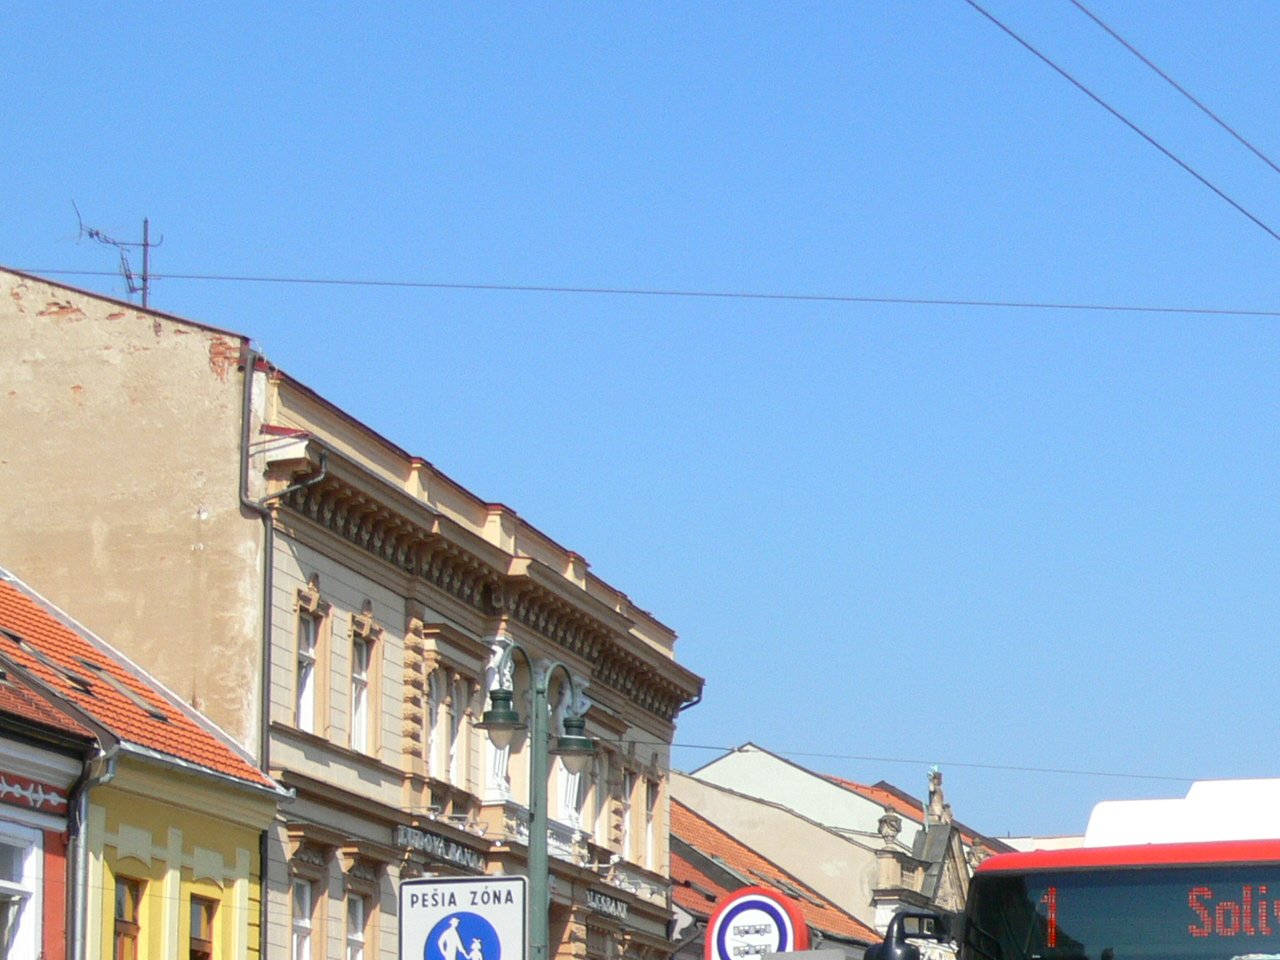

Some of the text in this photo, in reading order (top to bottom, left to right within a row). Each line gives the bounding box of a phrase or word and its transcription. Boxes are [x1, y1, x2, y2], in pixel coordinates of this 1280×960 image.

[411, 886, 514, 908] PEŠIA ZÓNA
[1040, 886, 1057, 948] 1
